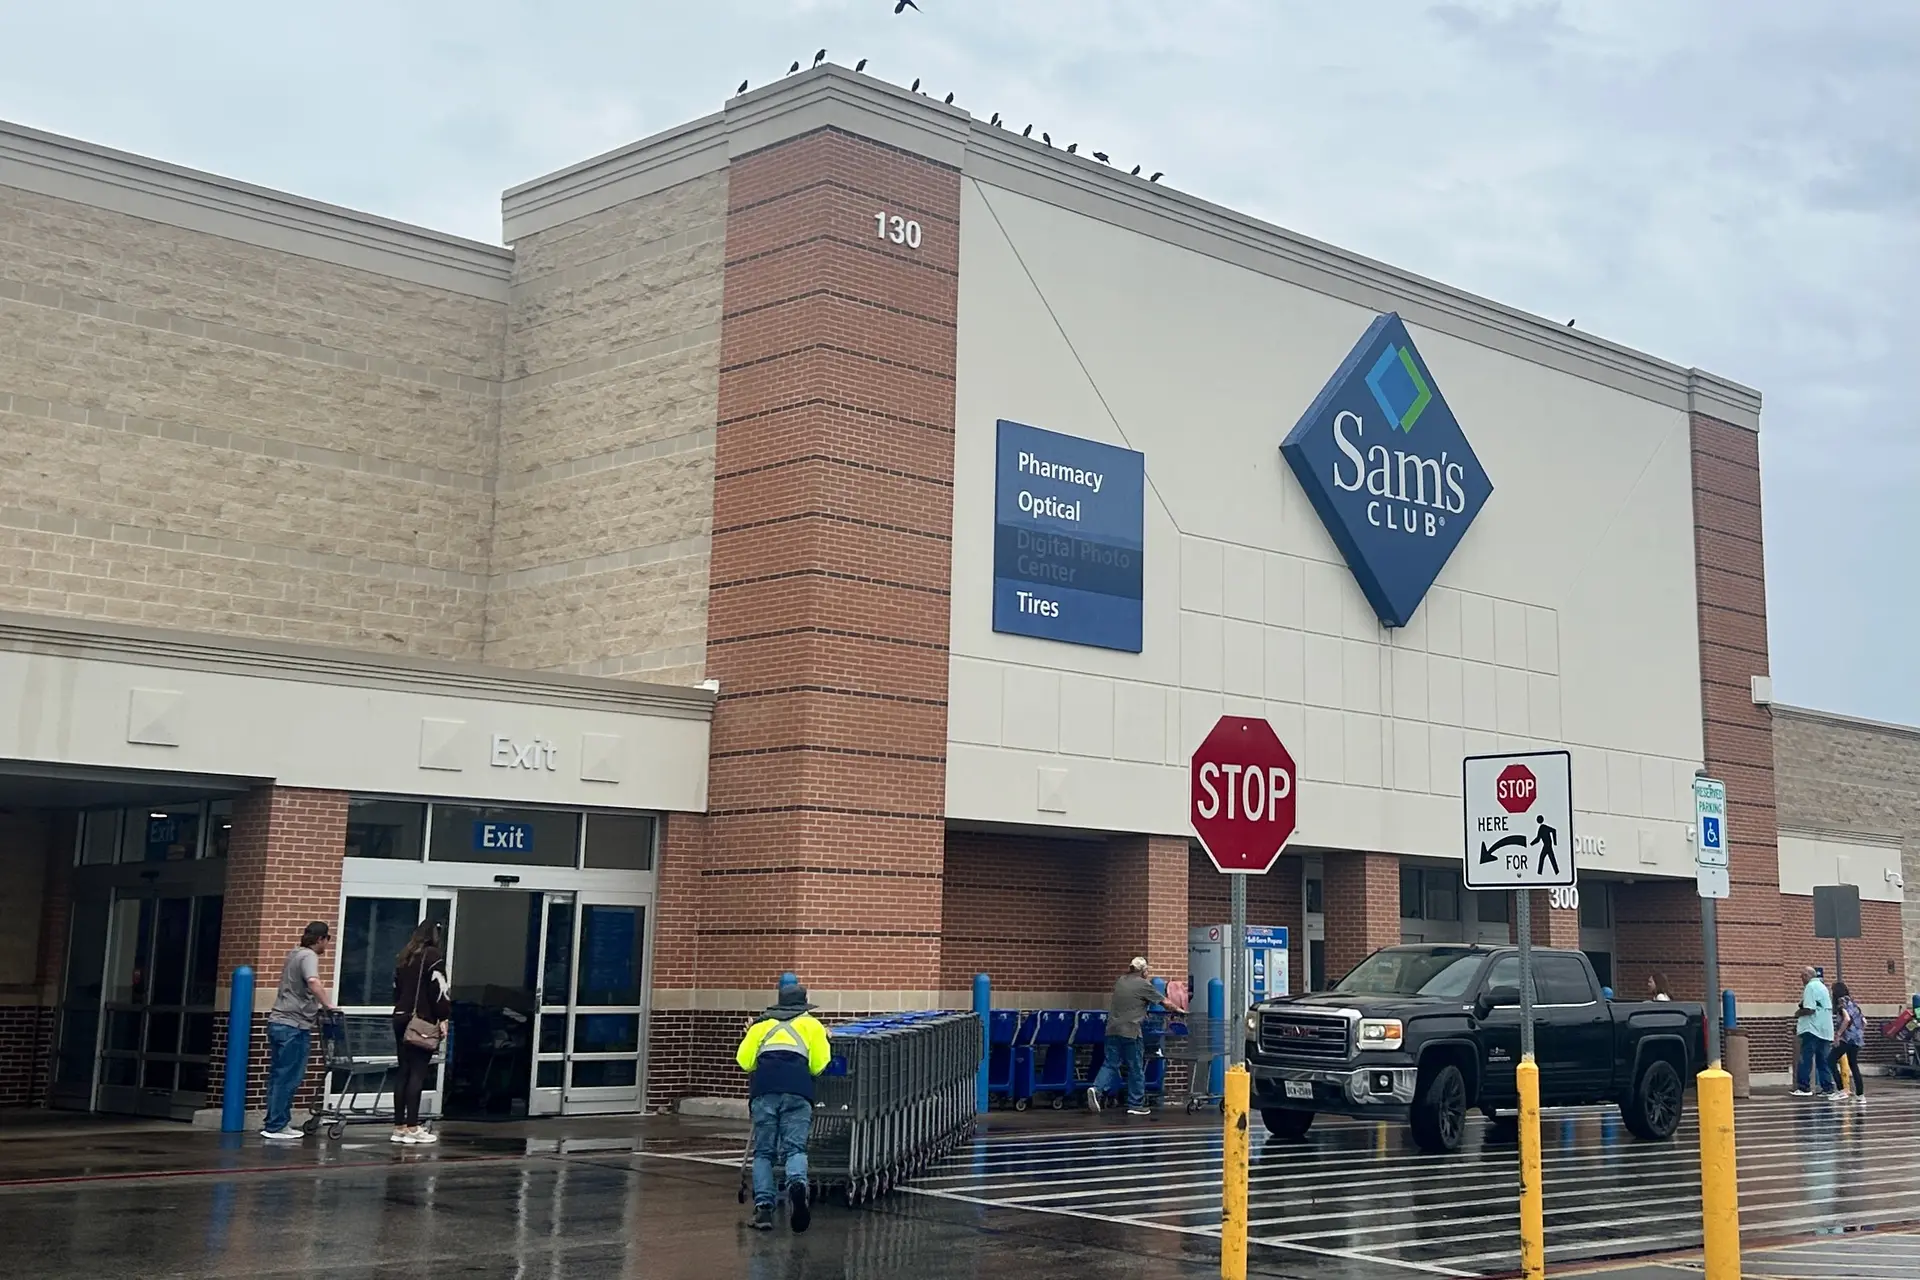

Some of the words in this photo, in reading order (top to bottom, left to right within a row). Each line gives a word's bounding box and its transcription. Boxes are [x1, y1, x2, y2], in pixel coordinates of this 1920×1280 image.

[874, 211, 922, 249] 130
[1017, 451, 1104, 493] Pharmacy
[1332, 410, 1466, 514] Sam's
[1018, 490, 1081, 521] Optical
[1017, 529, 1076, 559] Digital
[1081, 541, 1130, 569] Photo
[1017, 554, 1077, 583] Center
[1016, 591, 1060, 618] Tires
[490, 734, 557, 772] Exit
[1197, 761, 1291, 822] STOP
[1499, 778, 1535, 799] STOP
[1696, 786, 1723, 800] RESERVED
[1698, 801, 1722, 814] PARKING
[483, 824, 524, 849] Exit
[1478, 816, 1509, 832] HERE
[1506, 854, 1528, 870] FOR
[1550, 886, 1579, 910] 300
